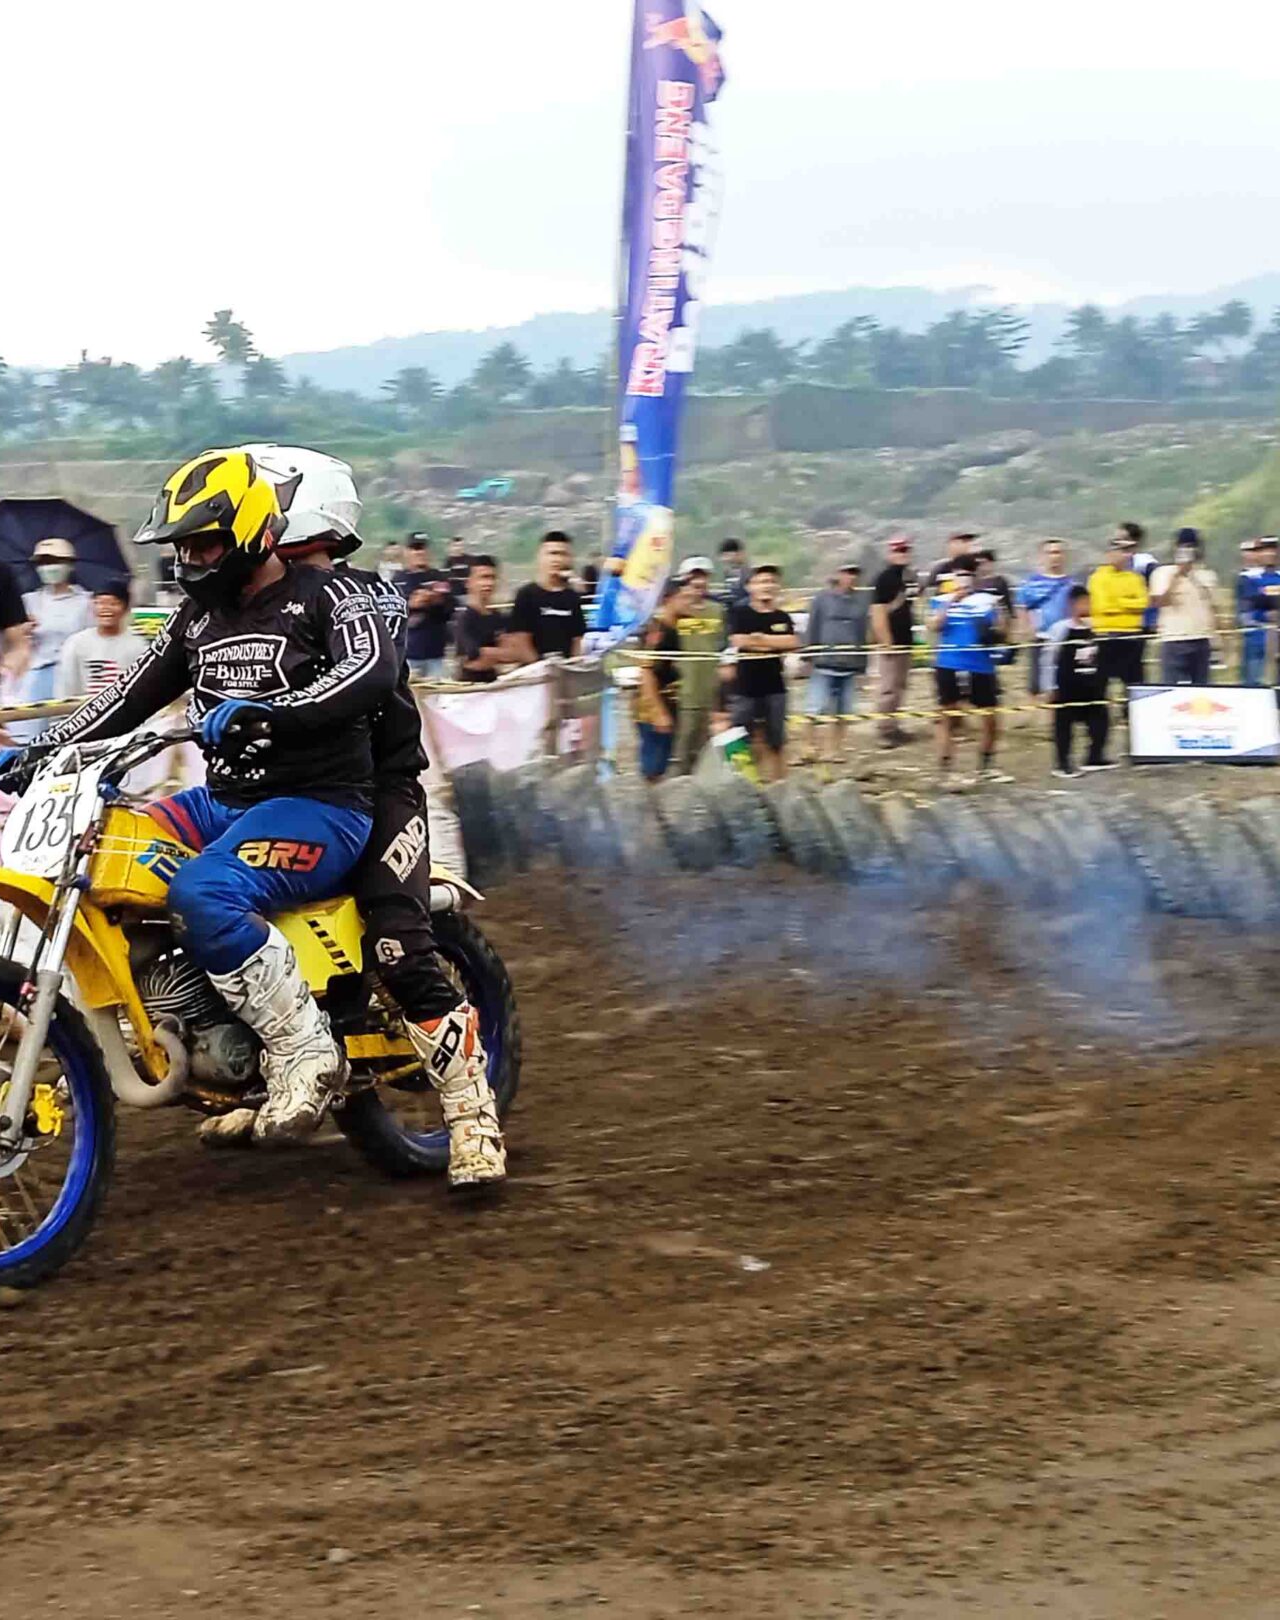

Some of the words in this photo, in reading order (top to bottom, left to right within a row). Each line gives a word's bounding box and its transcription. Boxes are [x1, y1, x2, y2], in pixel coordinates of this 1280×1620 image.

[626, 80, 695, 397] KRATINGDAENG
[216, 664, 265, 681] BUILT
[12, 792, 82, 853] 135
[237, 840, 324, 872] BRY
